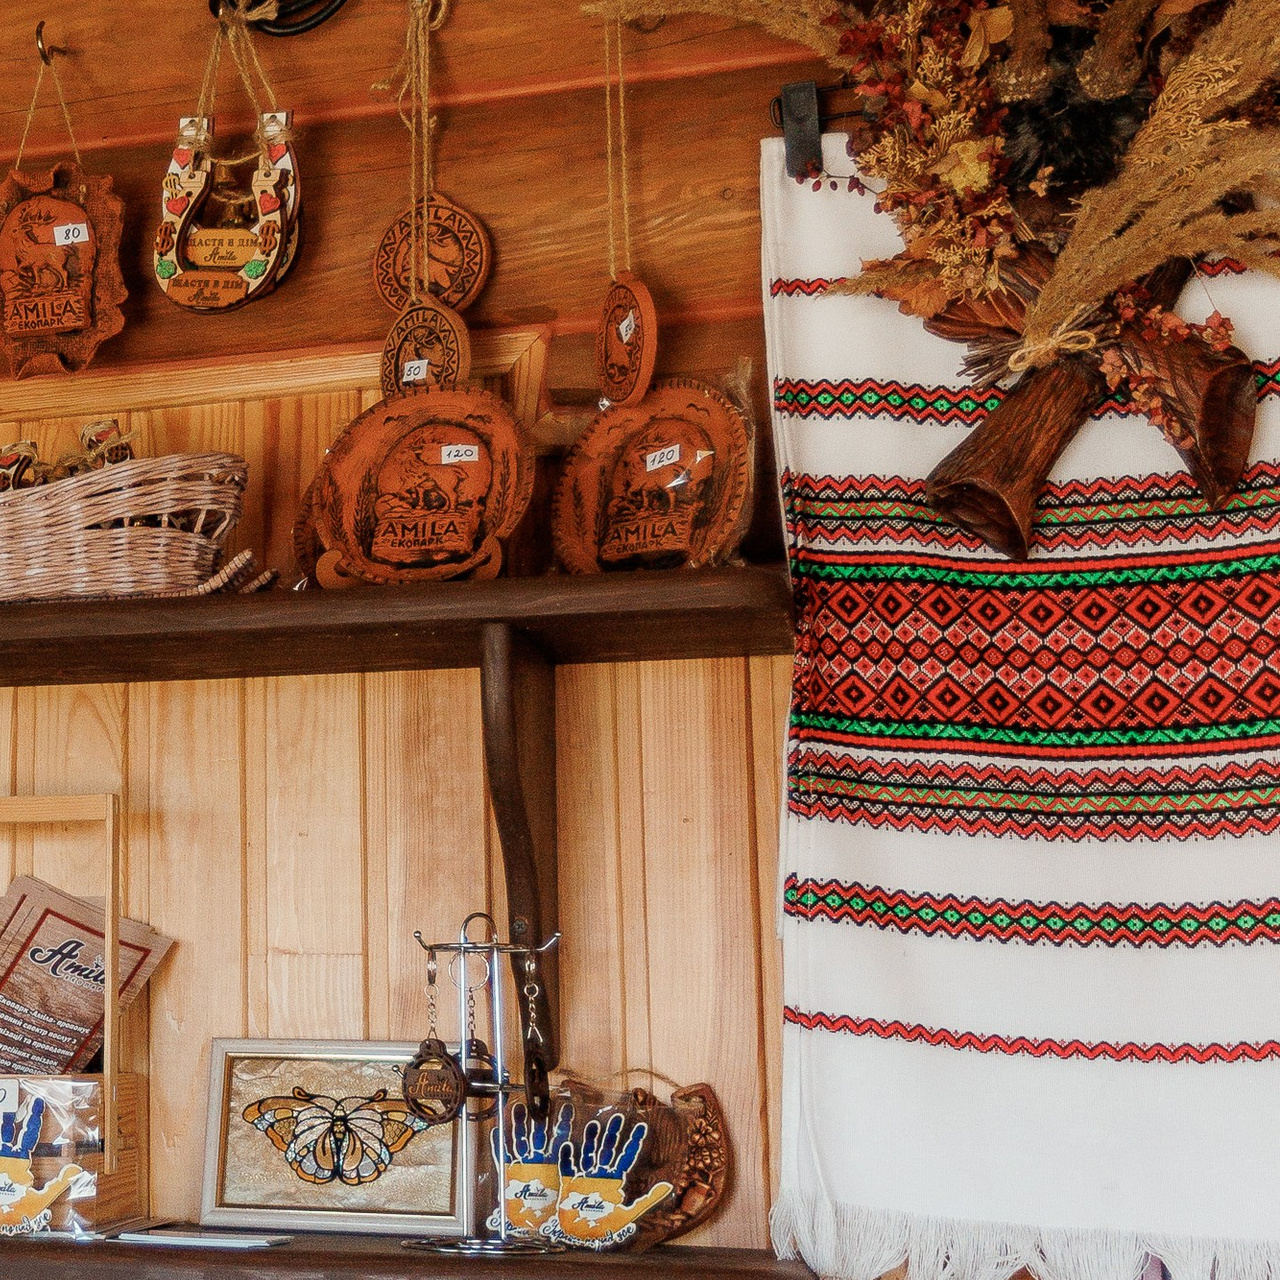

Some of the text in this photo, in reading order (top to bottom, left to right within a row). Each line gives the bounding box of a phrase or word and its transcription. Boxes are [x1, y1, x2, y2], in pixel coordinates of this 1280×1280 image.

[64, 227, 80, 240] 80
[204, 247, 237, 264] Amila
[10, 299, 77, 320] AMILA
[18, 317, 64, 330] ЕКОПАРК
[397, 311, 441, 338] AMILA
[407, 365, 421, 377] 50
[446, 449, 474, 459] 120
[650, 449, 675, 466] 120
[381, 521, 460, 538] AMILA
[611, 521, 678, 543] AMILA
[390, 537, 443, 549] ЕКОПАРК
[616, 540, 663, 553] ЕКОПАРК
[64, 975, 105, 994] ЕКОПАР
[22, 1023, 48, 1036] спектр
[48, 1031, 72, 1044] послуг
[56, 1020, 91, 1034] пропонує
[23, 1037, 32, 1045] та
[31, 1041, 75, 1057] проведення
[408, 1072, 453, 1097] Amila
[515, 1184, 548, 1200] Amila
[572, 1197, 605, 1211] Amila
